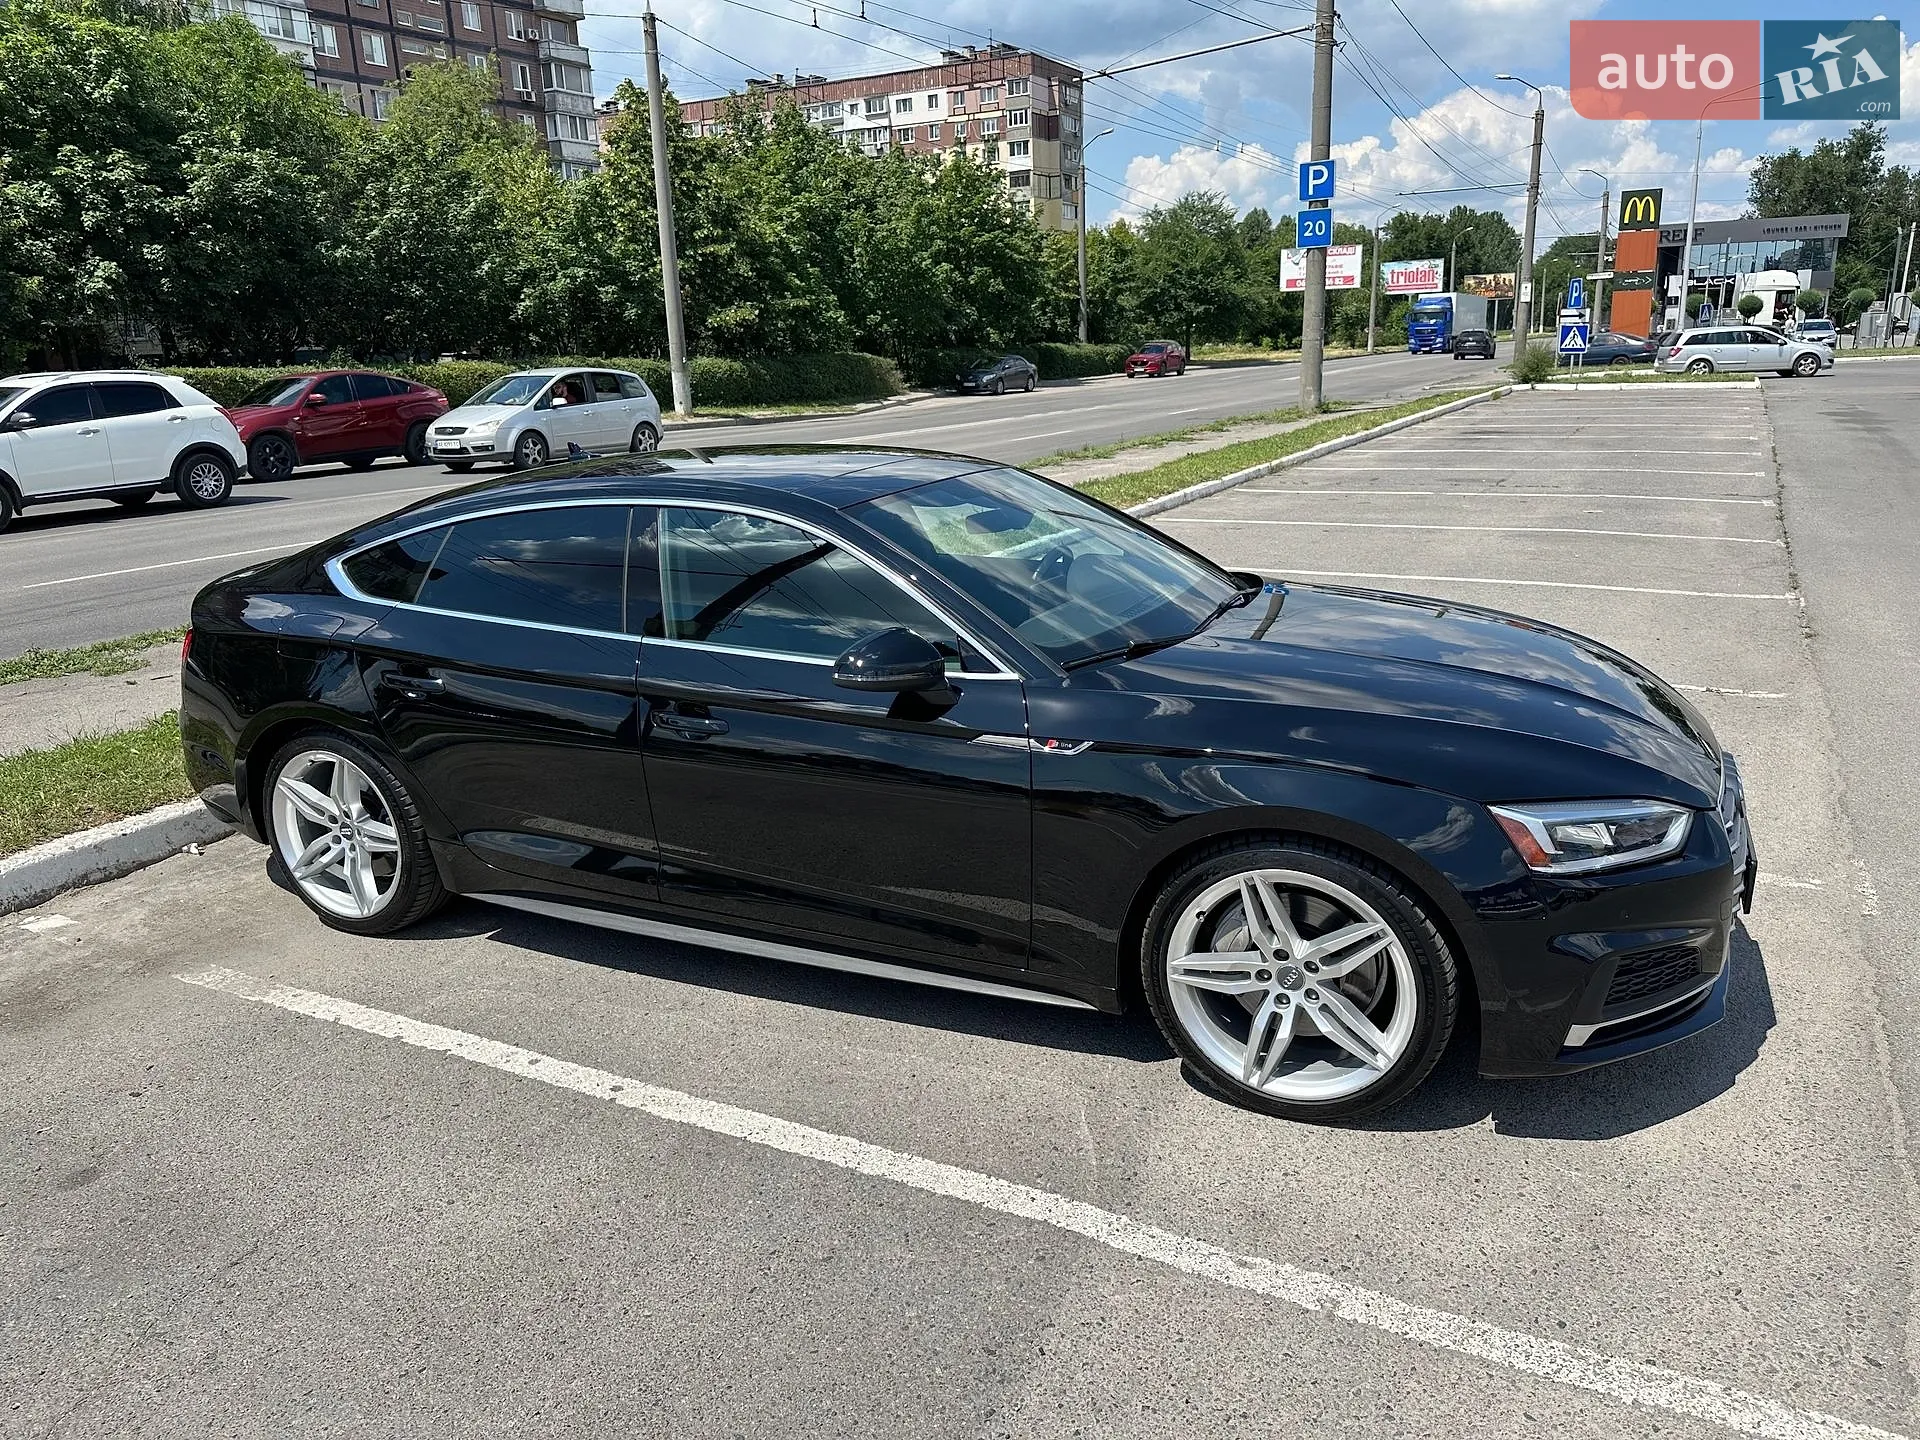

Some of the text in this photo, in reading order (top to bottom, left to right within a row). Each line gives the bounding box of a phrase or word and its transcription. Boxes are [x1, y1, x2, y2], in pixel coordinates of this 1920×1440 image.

[1308, 164, 1329, 196] P
[1303, 219, 1326, 237] 20
[1794, 225, 1808, 233] BAR
[1813, 223, 1842, 232] KITCHEN
[1389, 267, 1435, 285] triolan
[1571, 282, 1580, 306] P
